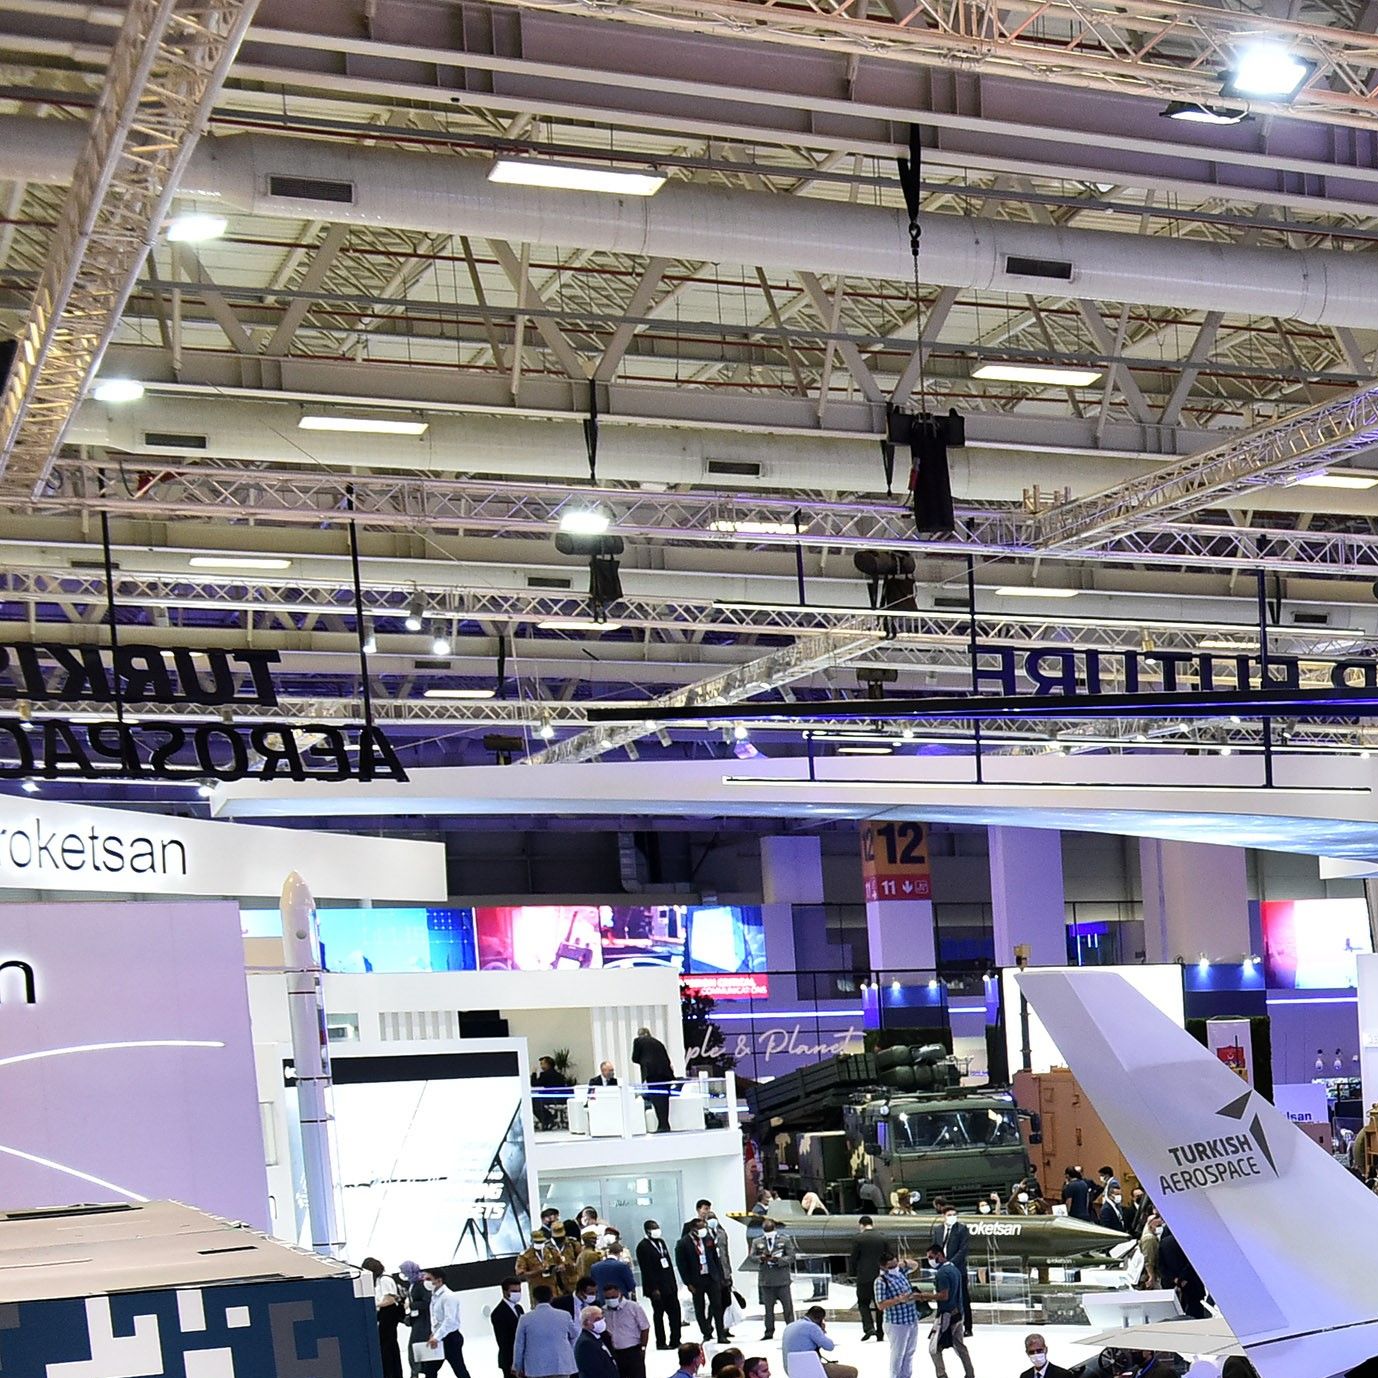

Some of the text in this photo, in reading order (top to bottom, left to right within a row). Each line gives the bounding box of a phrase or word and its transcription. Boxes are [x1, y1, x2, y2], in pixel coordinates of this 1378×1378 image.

[877, 821, 926, 865] 12
[881, 880, 896, 896] 11
[1168, 1134, 1253, 1167] TURKISH
[1159, 1156, 1261, 1196] AEROSPACE
[967, 1221, 1022, 1237] roketsan
